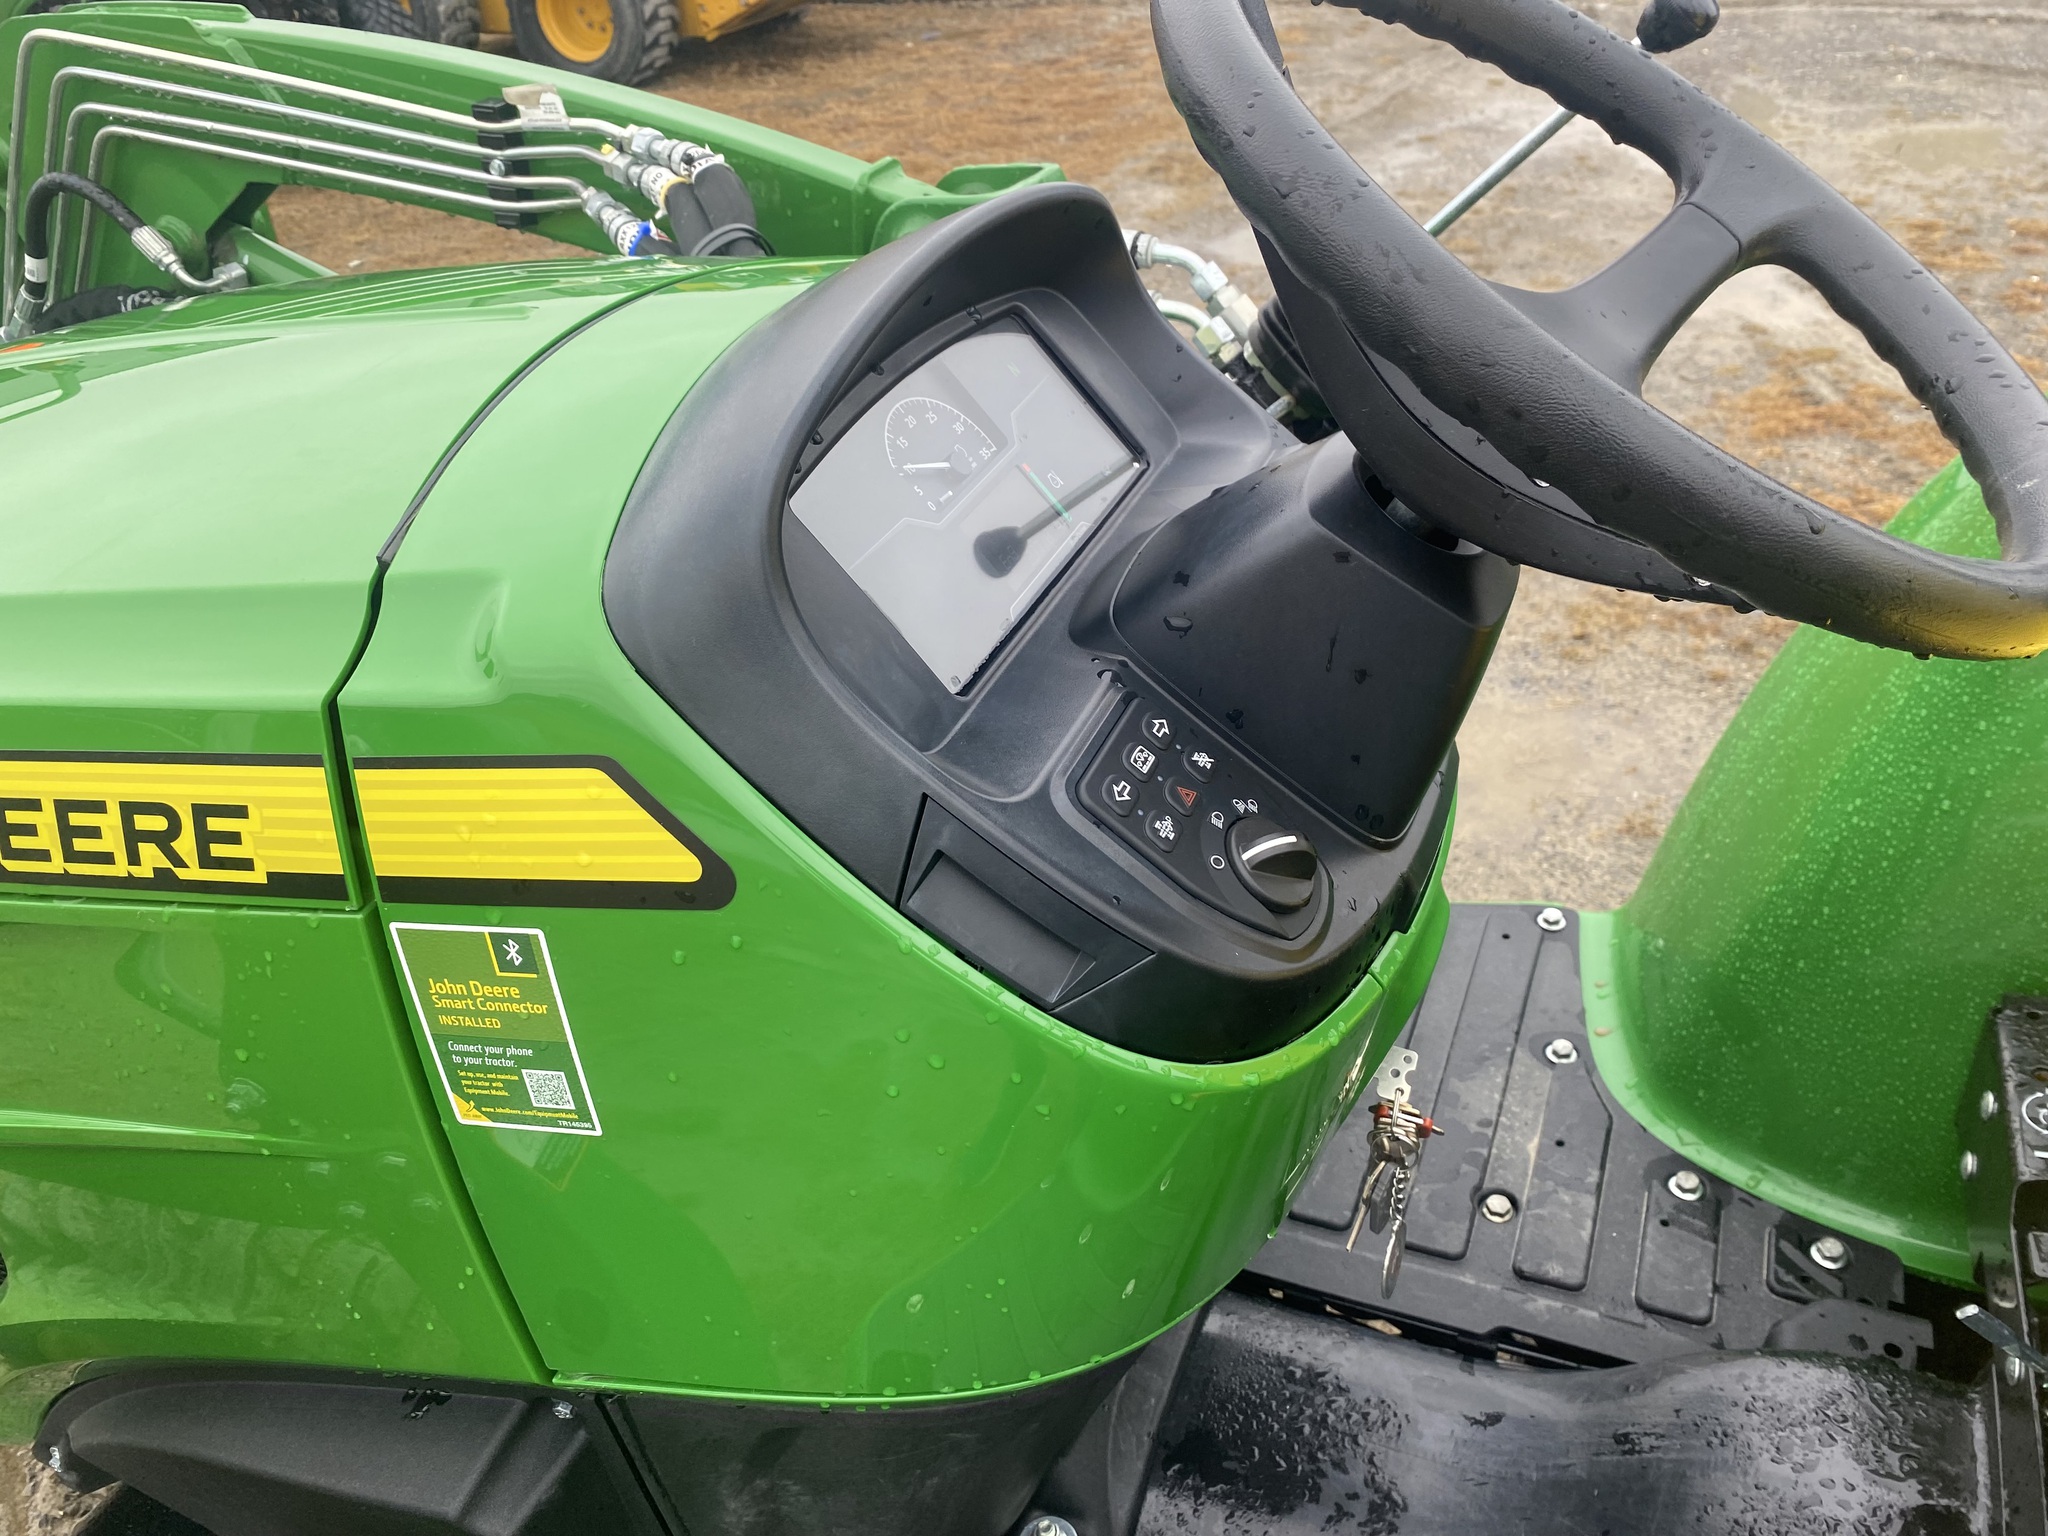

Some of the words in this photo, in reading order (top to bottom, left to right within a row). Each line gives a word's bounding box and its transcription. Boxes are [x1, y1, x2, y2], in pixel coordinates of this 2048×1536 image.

[904, 415, 917, 429] 20
[925, 411, 938, 424] 25
[952, 422, 965, 435] 30
[896, 436, 909, 449] 15
[979, 447, 991, 460] 35
[913, 485, 924, 496] 5
[927, 501, 937, 511] 0
[0, 797, 256, 872] EERE
[428, 978, 468, 996] John
[469, 980, 521, 998] Deere
[431, 995, 476, 1010] Smart
[476, 997, 549, 1015] Connector
[438, 1014, 501, 1029] INSTALLED
[447, 1040, 483, 1053] Connect
[484, 1046, 504, 1056] your
[506, 1045, 534, 1057] phone
[452, 1053, 462, 1064] to
[463, 1057, 483, 1067] your
[485, 1056, 518, 1068] tractor.
[463, 1086, 491, 1095] Equipment
